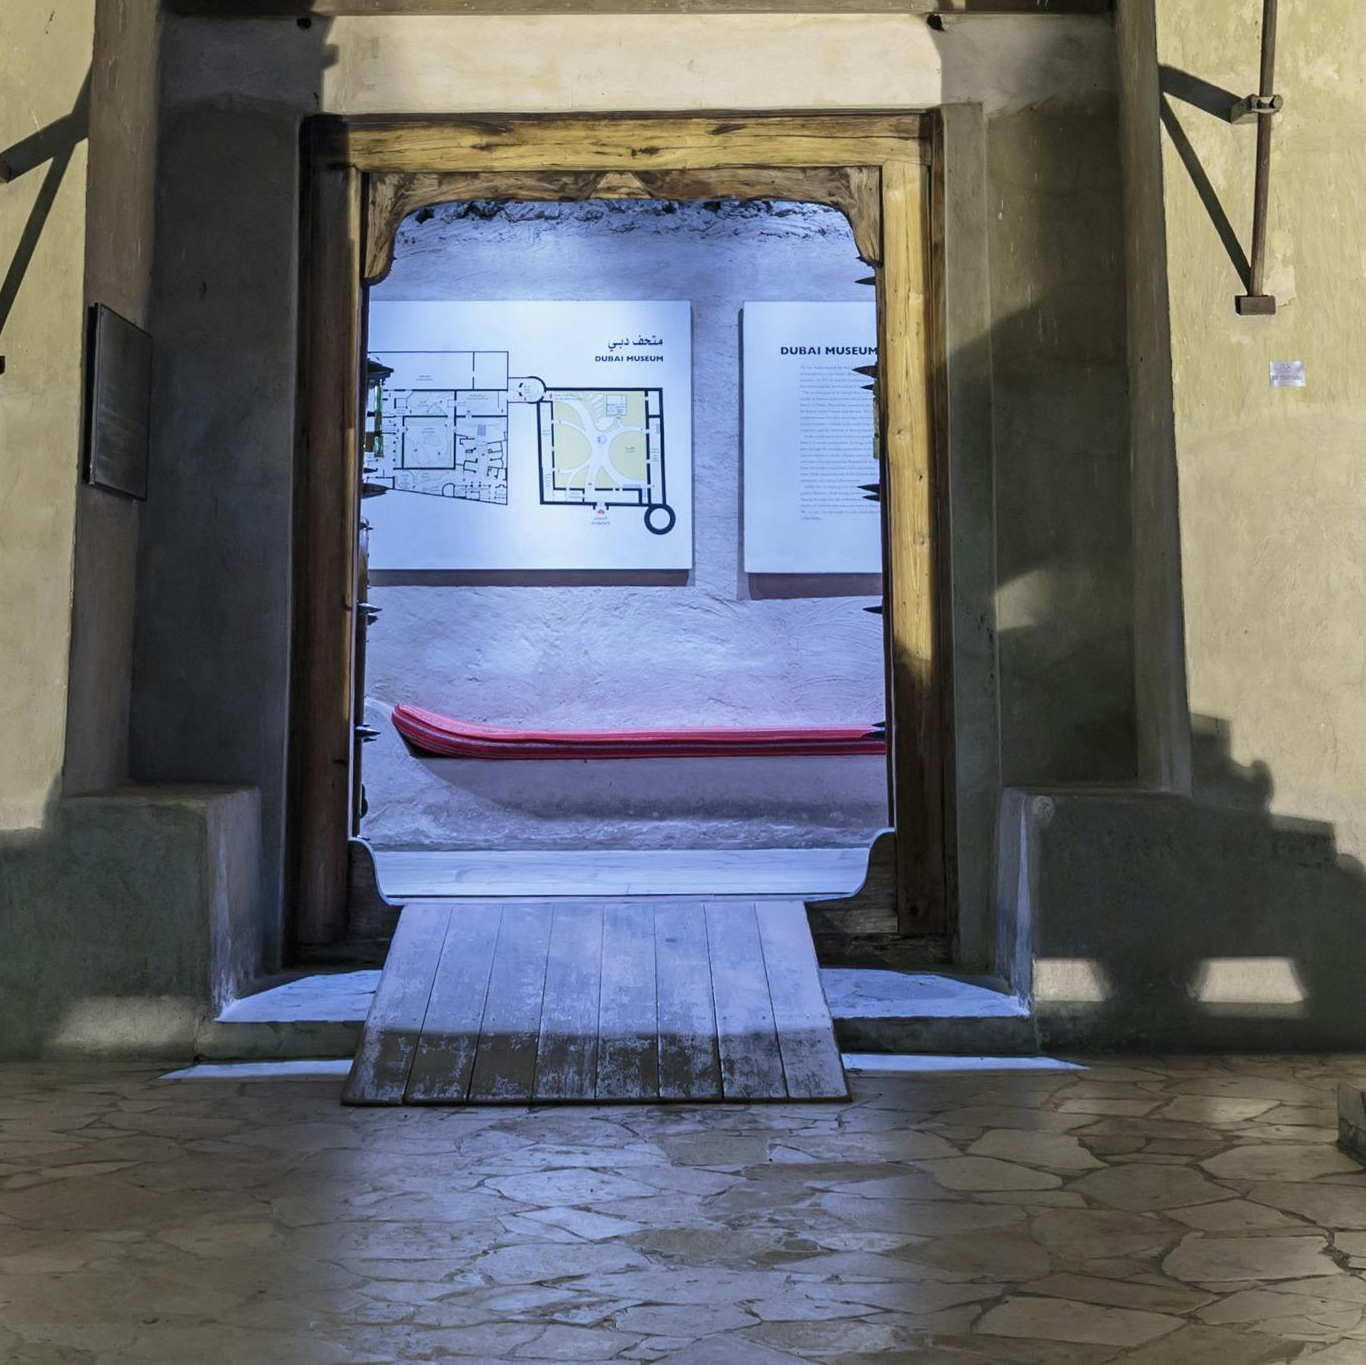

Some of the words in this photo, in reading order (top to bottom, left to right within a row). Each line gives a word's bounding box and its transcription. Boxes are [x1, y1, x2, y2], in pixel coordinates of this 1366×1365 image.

[607, 336, 630, 352] دبي
[632, 334, 664, 347] متحف
[780, 346, 821, 356] DUBAI
[825, 346, 878, 356] MUSEUM
